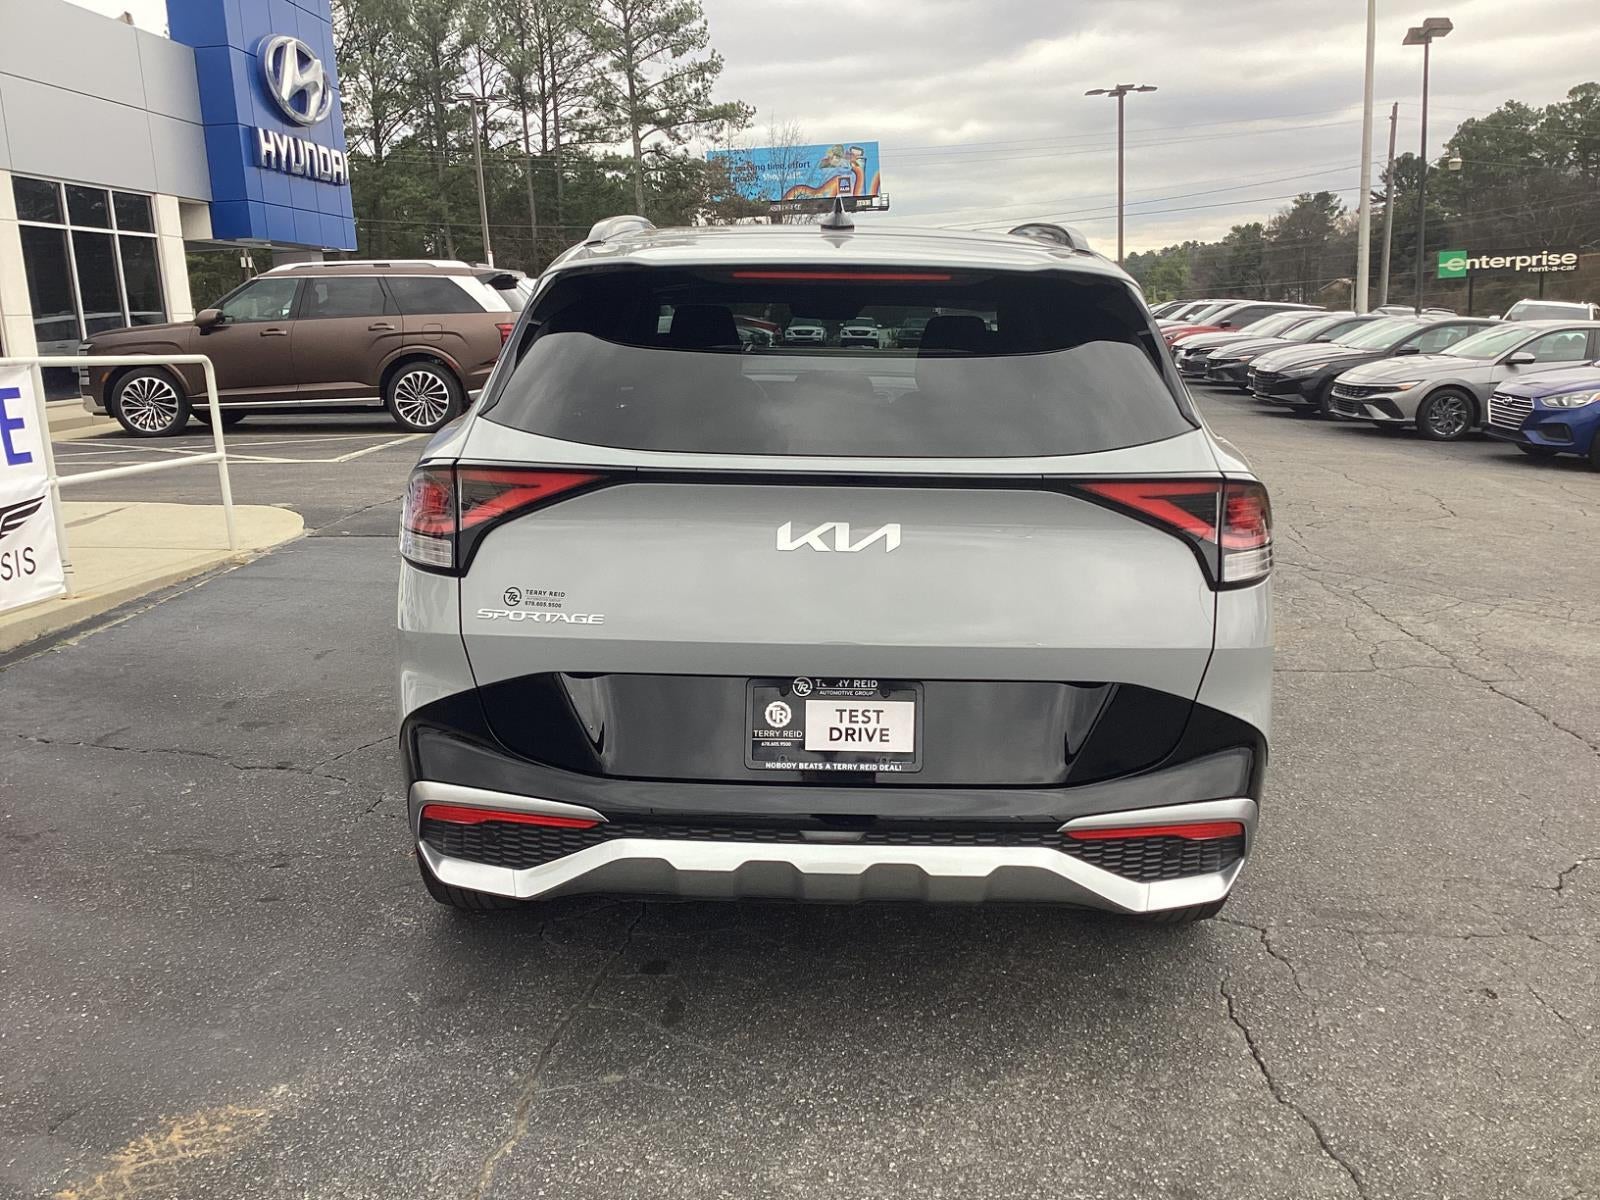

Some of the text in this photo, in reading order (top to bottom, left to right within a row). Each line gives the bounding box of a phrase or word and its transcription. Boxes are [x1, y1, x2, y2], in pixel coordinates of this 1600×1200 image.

[258, 127, 350, 185] HYUNDAI
[1439, 250, 1578, 271] enterprise
[1528, 265, 1577, 273] rent-a-car
[776, 520, 901, 553] KIA
[476, 608, 605, 625] SPORTAGE
[853, 679, 879, 688] REID
[835, 709, 885, 725] TEST
[753, 729, 803, 738] TERRY REID
[829, 727, 891, 743] DRIVE
